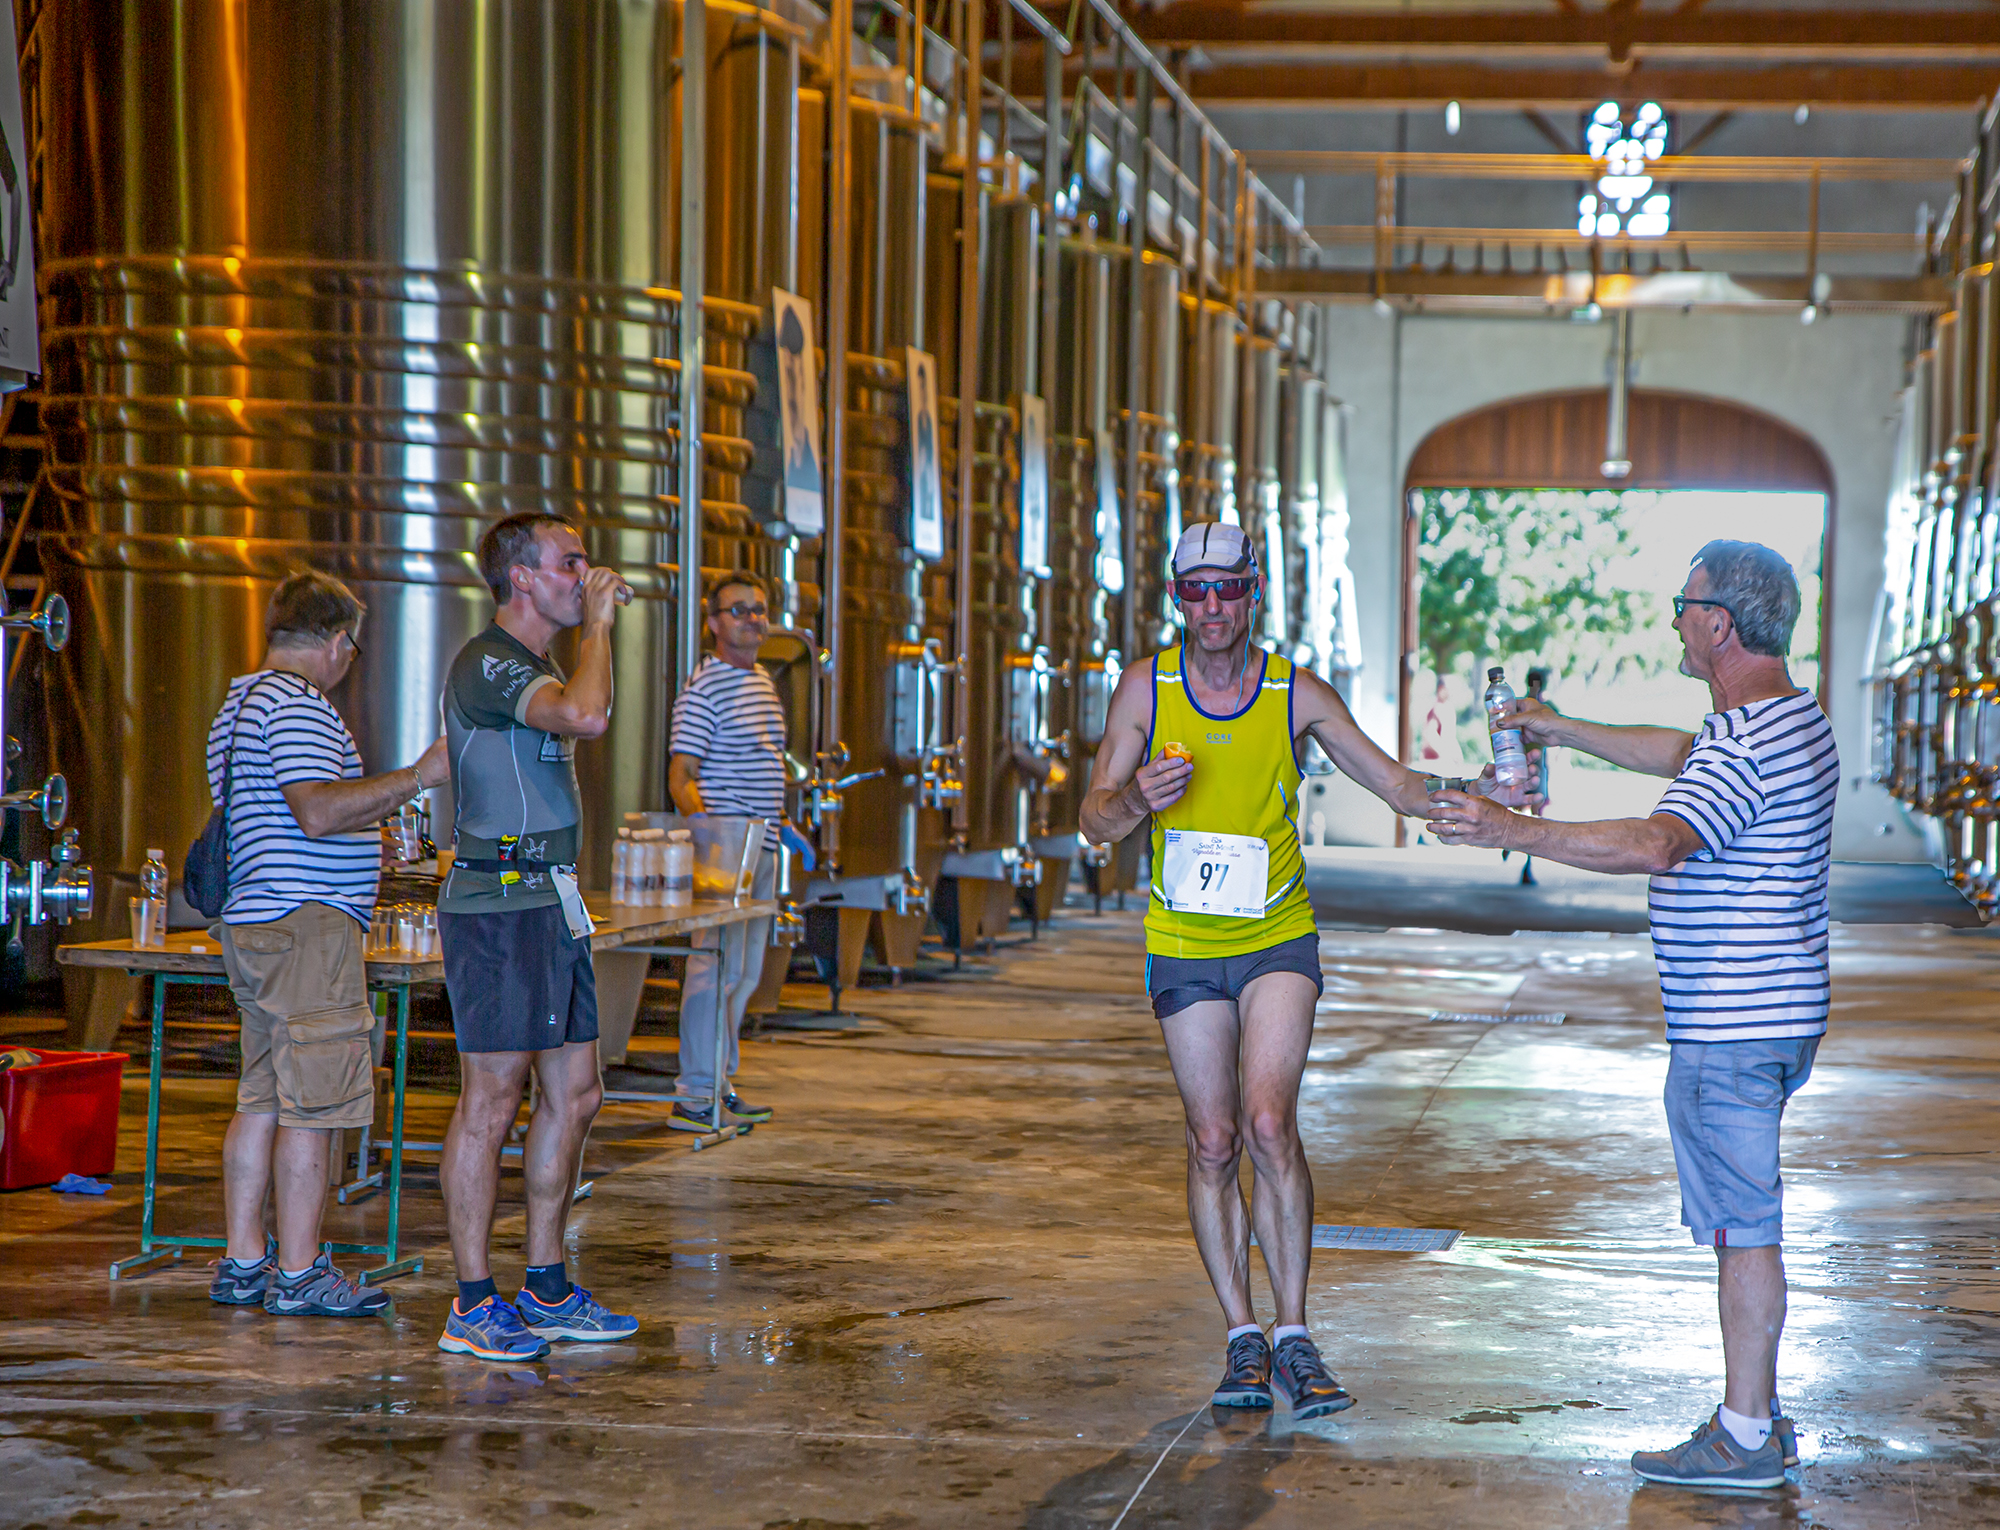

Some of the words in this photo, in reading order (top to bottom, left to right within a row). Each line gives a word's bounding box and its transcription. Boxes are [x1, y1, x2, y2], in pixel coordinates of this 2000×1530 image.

[1206, 732, 1231, 740] GORE
[1198, 842, 1215, 850] SAINT
[1200, 862, 1229, 892] 97
